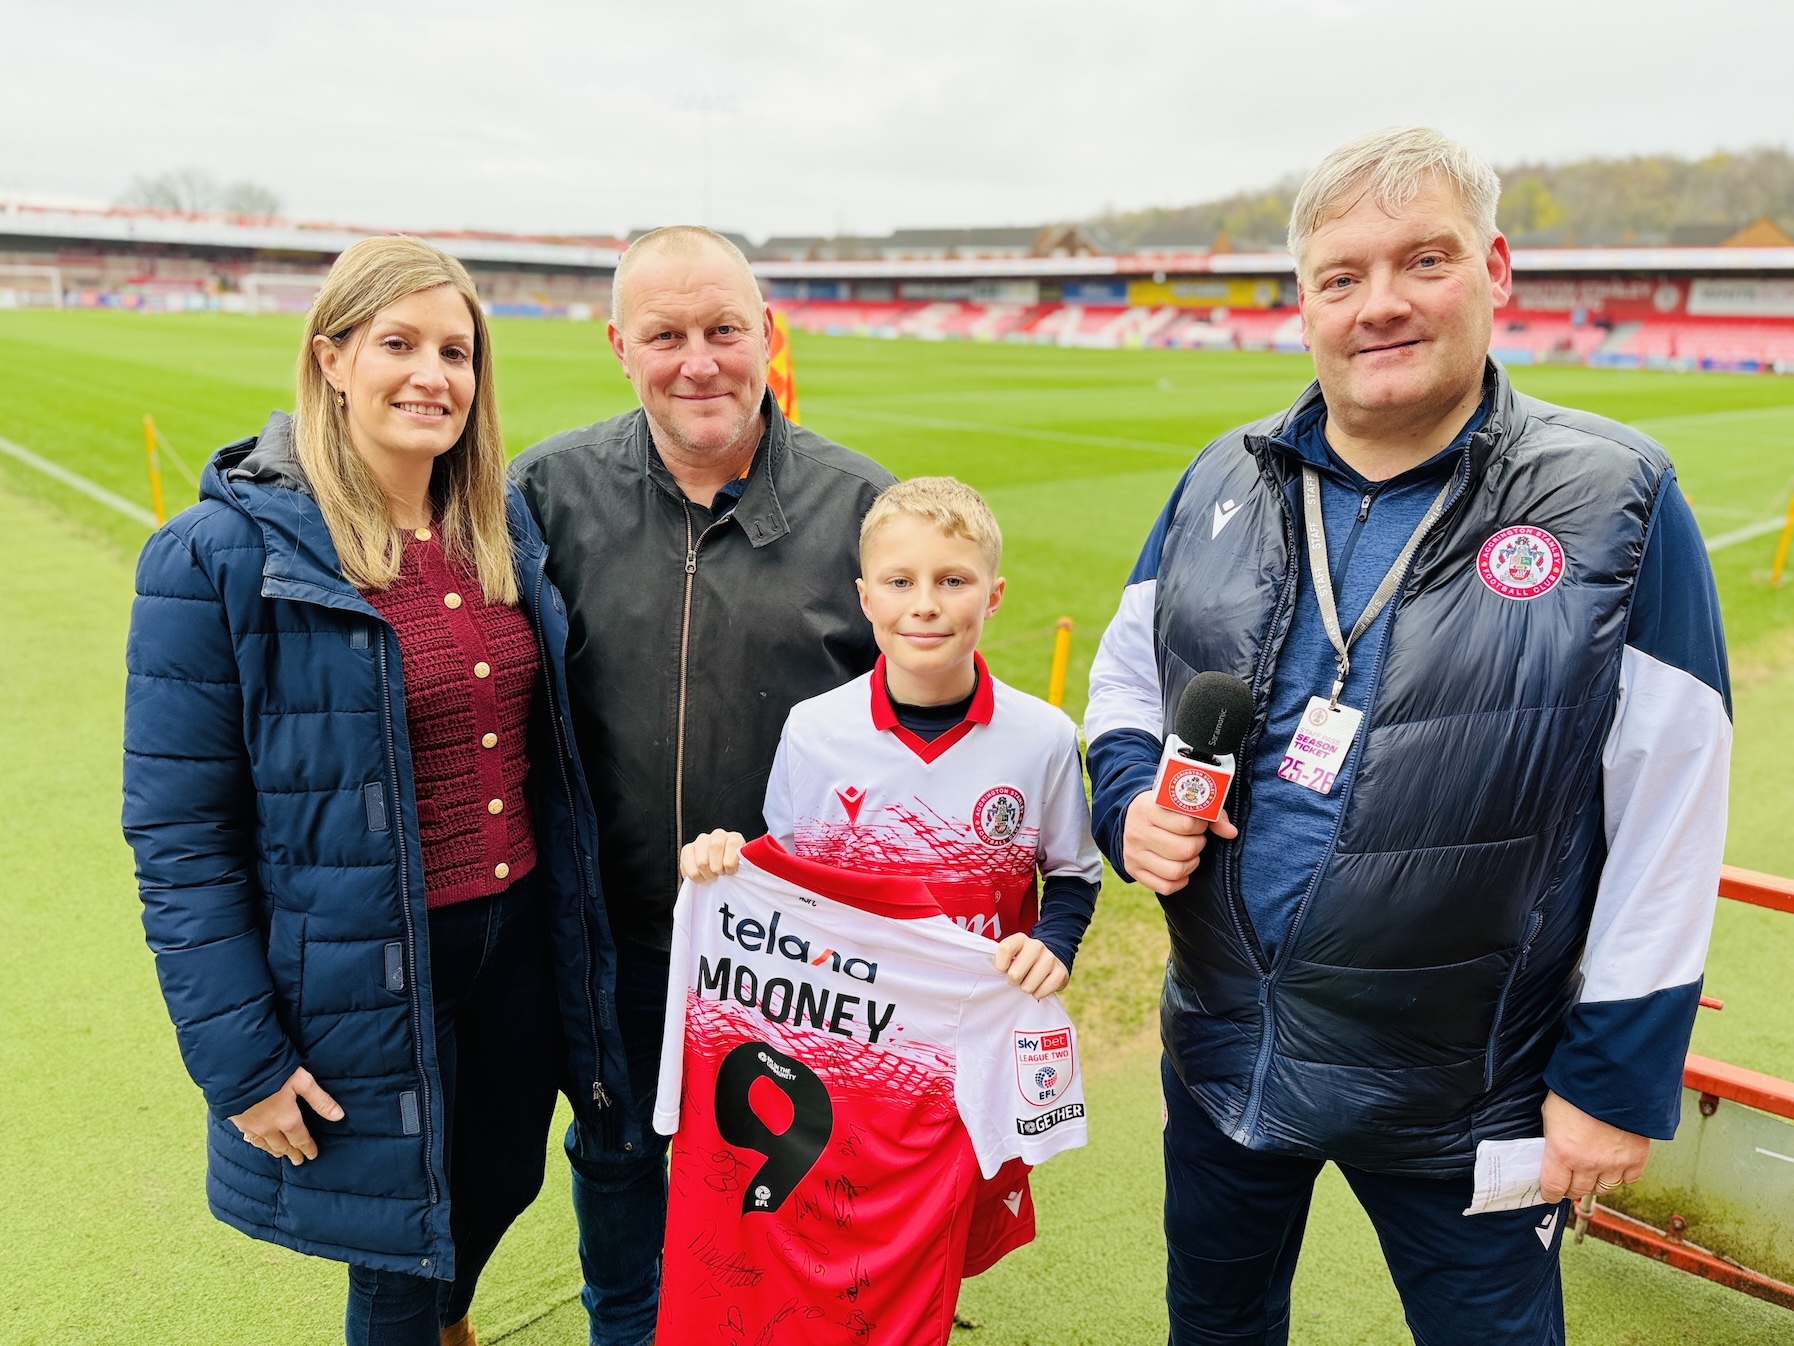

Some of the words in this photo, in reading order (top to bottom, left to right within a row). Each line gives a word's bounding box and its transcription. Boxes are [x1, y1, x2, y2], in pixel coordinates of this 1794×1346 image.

[1306, 475, 1316, 505] STAFF
[1309, 522, 1321, 550] STAFF
[1482, 528, 1533, 558] ACCRINGTON
[1535, 529, 1561, 564] STANLEY
[1314, 566, 1327, 597] STAFF
[1482, 568, 1529, 596] FOOTBALL
[1532, 574, 1556, 594] CLUB
[1358, 600, 1383, 631] STAFF
[1326, 616, 1341, 647] STAFF
[1208, 708, 1227, 747] Saramonic
[1299, 727, 1320, 739] STAFF
[1294, 741, 1330, 759] TICKET
[1296, 733, 1338, 753] SEASON
[1278, 755, 1337, 795] 25-26
[975, 788, 1009, 817] ACCRINGTON
[1010, 790, 1024, 814] STANLEY
[976, 825, 1007, 845] FOOTBALL
[718, 901, 878, 984] telana
[697, 954, 896, 1043] MOONEY
[1018, 1037, 1039, 1051] sky
[1043, 1035, 1066, 1048] bet
[1020, 1053, 1049, 1062] LEAGUE
[1051, 1050, 1069, 1059] TWO
[1039, 1089, 1056, 1100] EFL
[714, 1041, 834, 1217] 9
[755, 1199, 769, 1208] EFL
